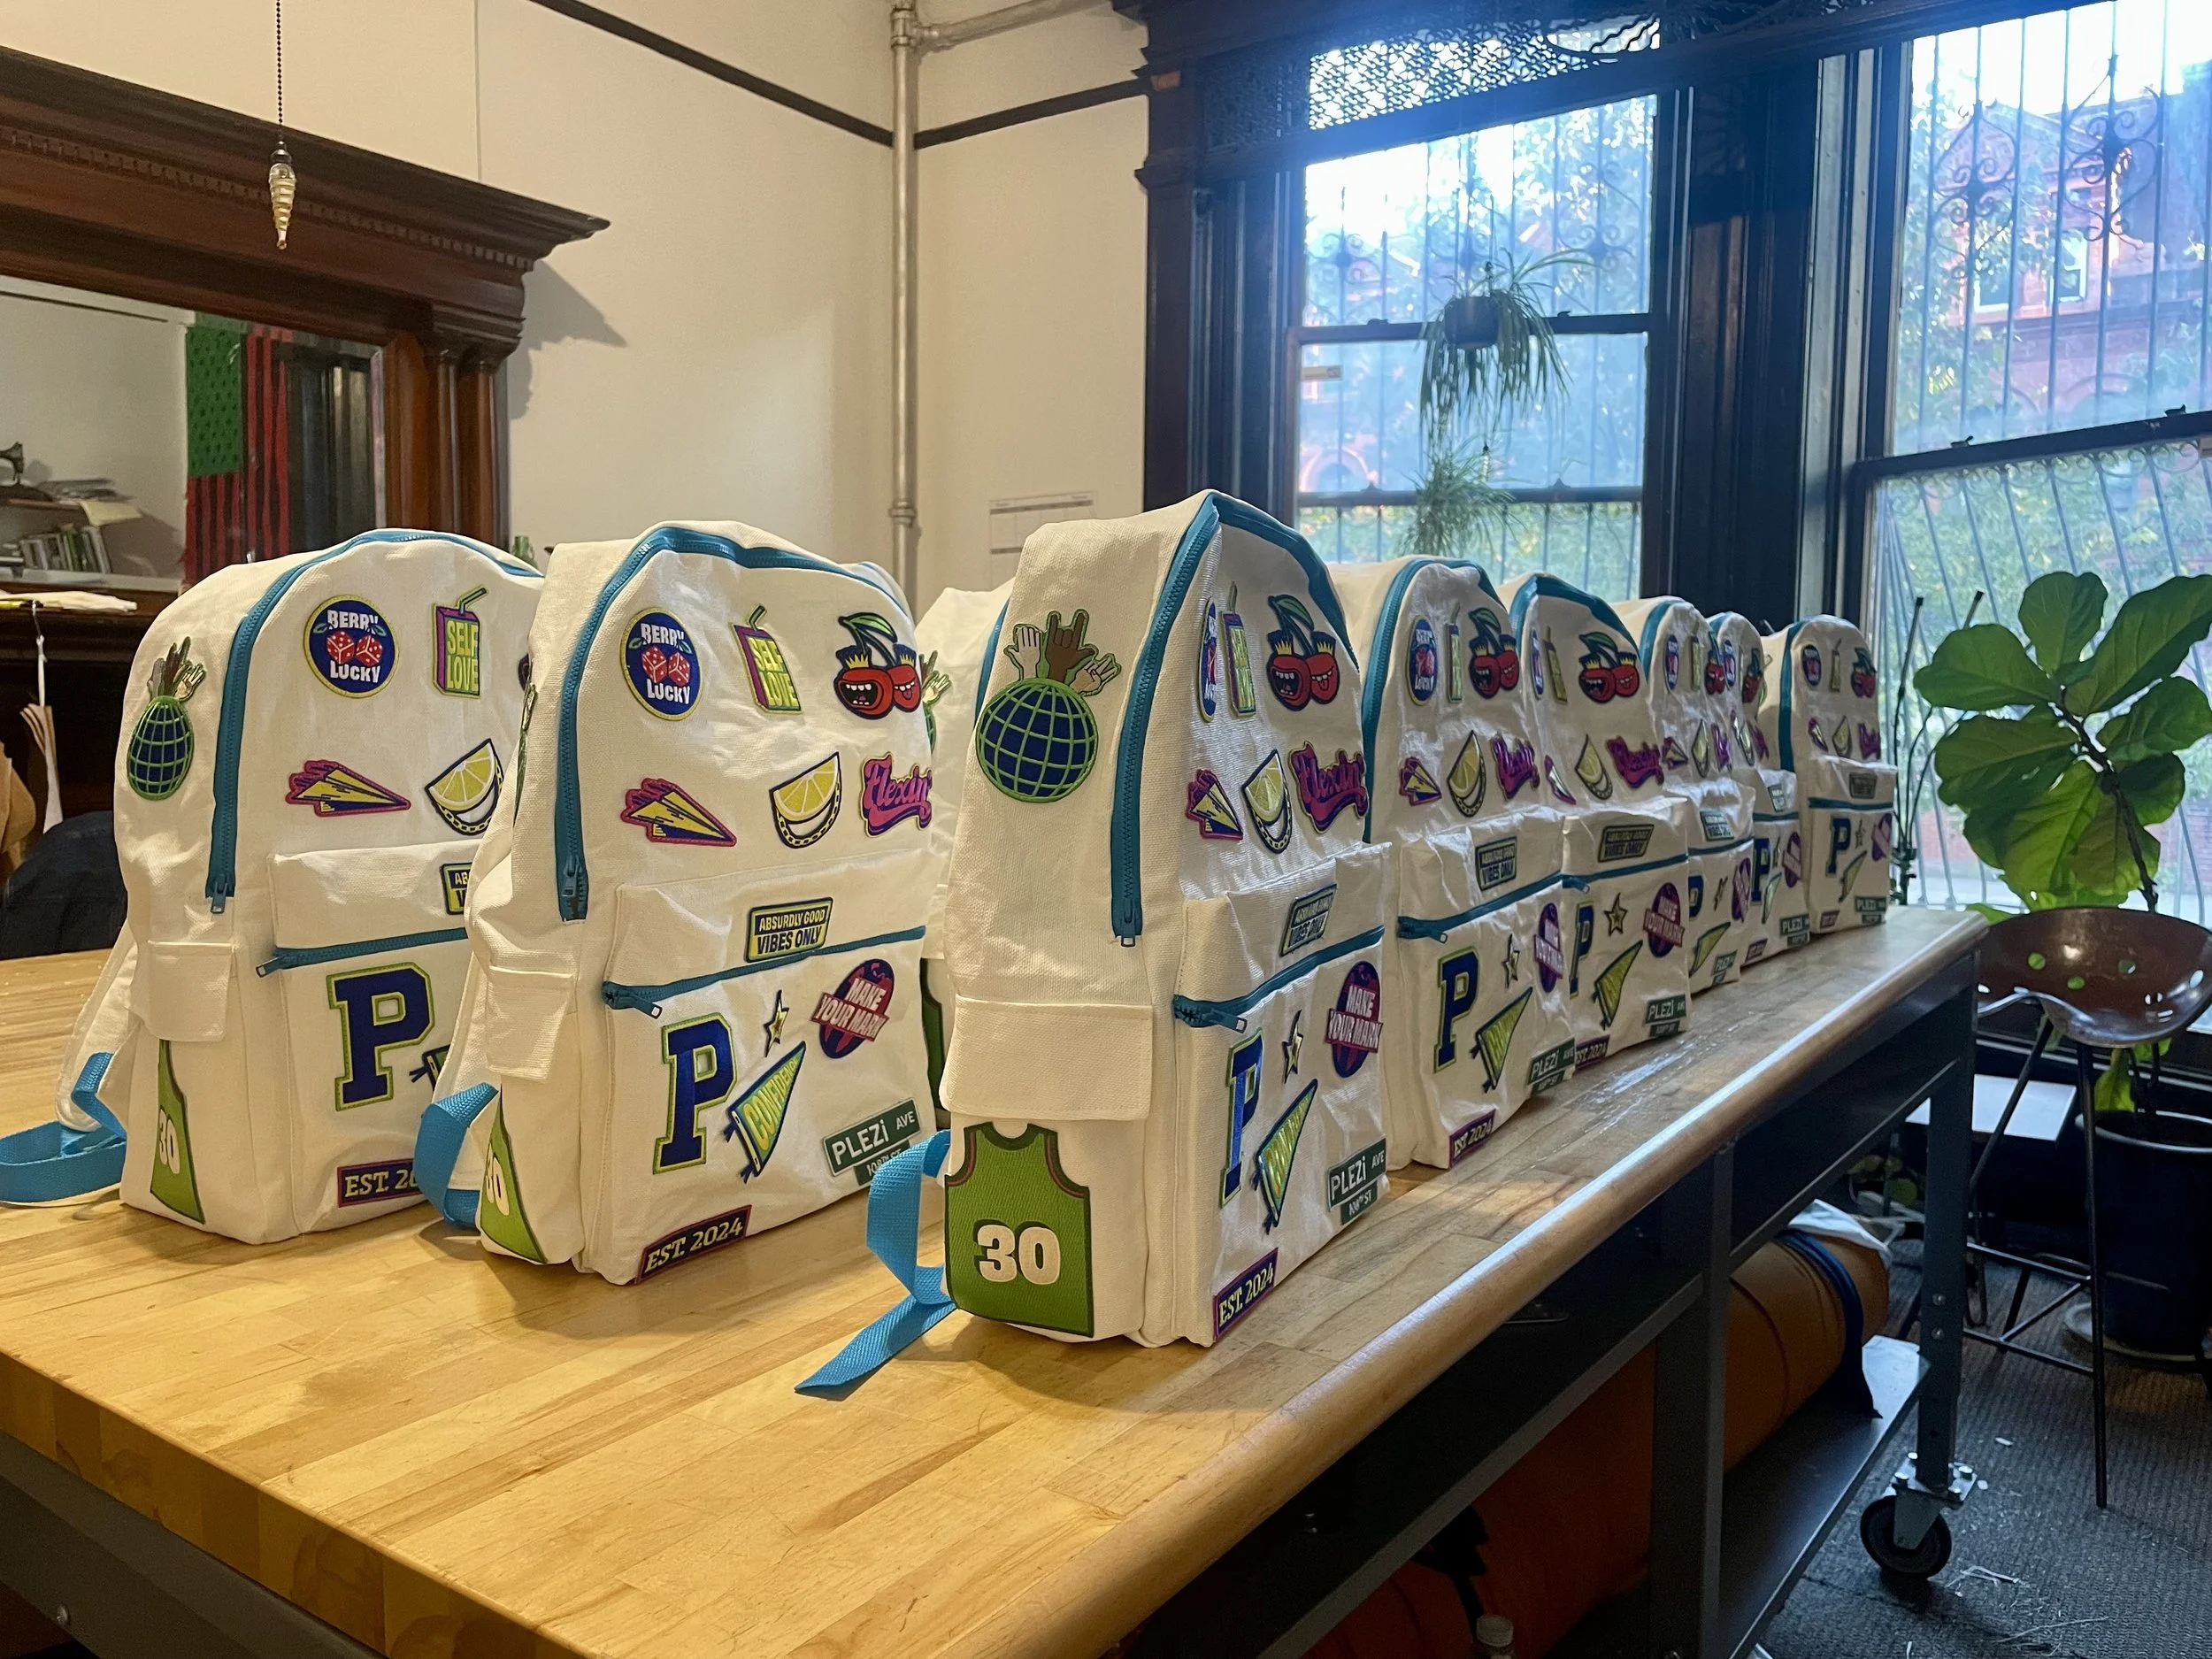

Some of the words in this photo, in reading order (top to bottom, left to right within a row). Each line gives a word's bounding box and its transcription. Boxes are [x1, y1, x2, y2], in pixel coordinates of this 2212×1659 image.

[327, 610, 379, 634] BERRY
[446, 620, 479, 657] SELF
[641, 623, 685, 651] BERRY
[330, 660, 380, 683] LUCKY
[748, 637, 785, 673] SELF
[446, 655, 479, 693] LOVE
[646, 678, 691, 705] LUCKY
[758, 671, 800, 707] LOVE
[1826, 812, 1853, 878] P
[758, 912, 803, 932] ABSURDLY
[803, 909, 826, 925] GOOD
[757, 931, 794, 955] VIBES
[795, 926, 823, 949] ONLY
[844, 978, 887, 1011] MAKE
[1345, 985, 1376, 1018] MAKE
[1433, 945, 1481, 1074] P
[815, 995, 856, 1028] YOUR
[846, 1009, 887, 1040] MARK
[1327, 1010, 1356, 1043] YOUR
[1351, 1018, 1382, 1049] MARK
[326, 962, 435, 1112] P
[652, 1012, 738, 1175] P
[895, 1110, 916, 1131] AVE
[1371, 1149, 1385, 1169] AVE
[691, 1216, 744, 1249] 2024
[974, 1220, 1062, 1286] 30
[1245, 1262, 1274, 1304] 2024
